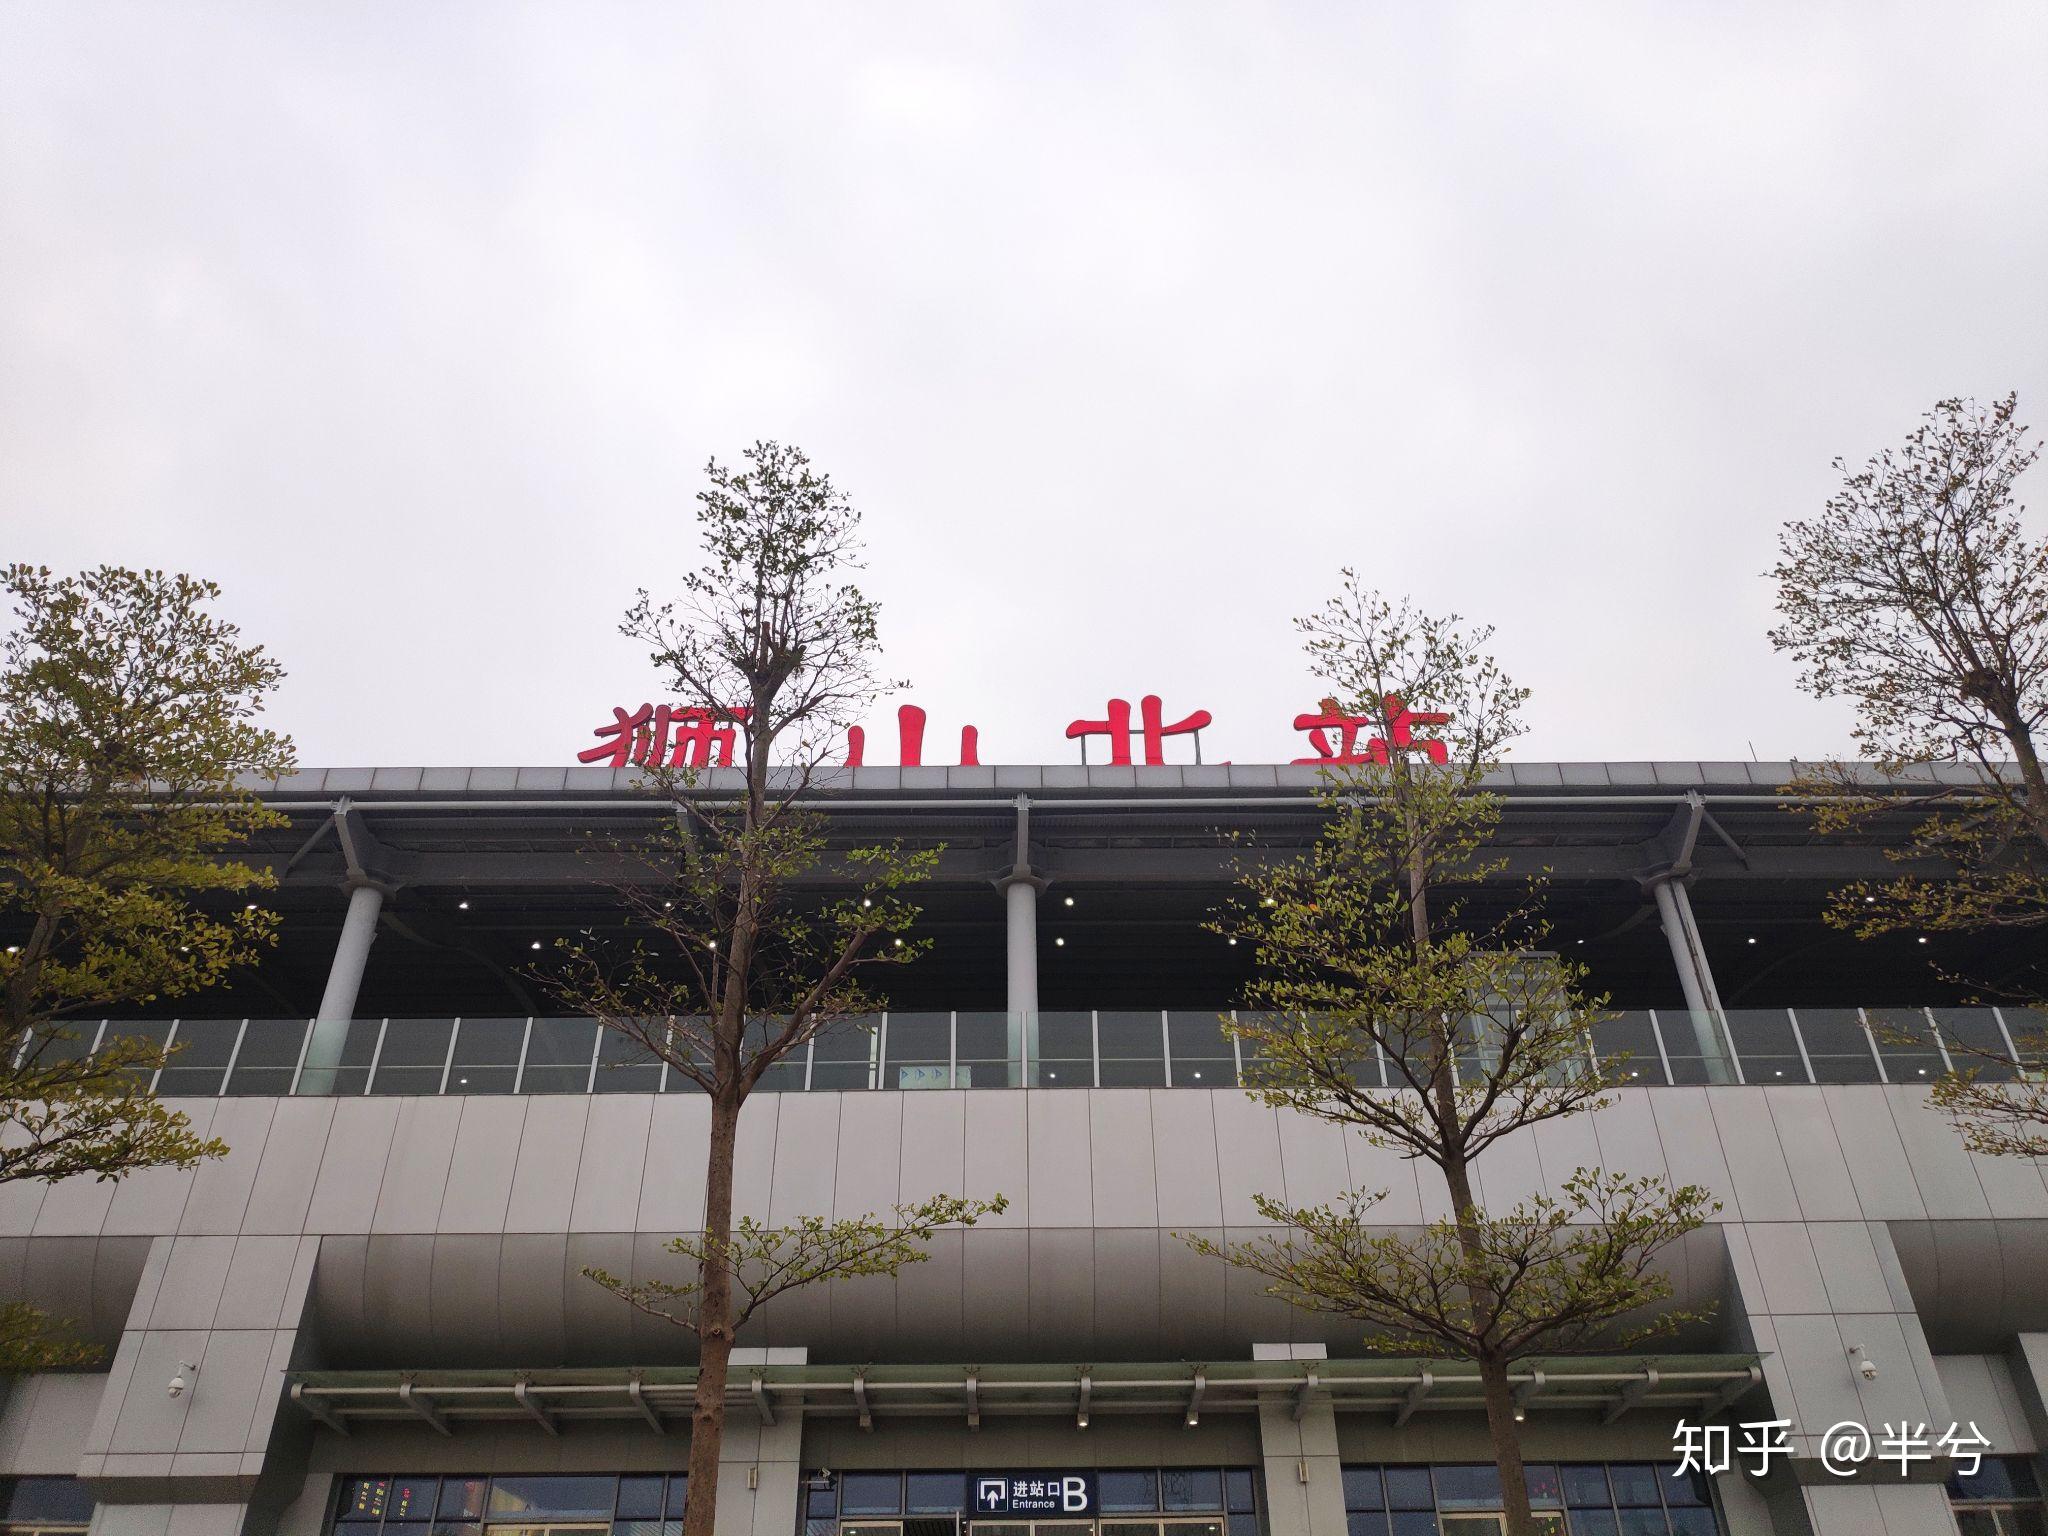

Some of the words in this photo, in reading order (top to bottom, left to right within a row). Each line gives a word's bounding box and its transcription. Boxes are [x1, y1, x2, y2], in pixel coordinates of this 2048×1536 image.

[1013, 1480, 1060, 1497] 进站口
[1063, 1476, 1088, 1511] B
[1012, 1499, 1055, 1509] Entrance
